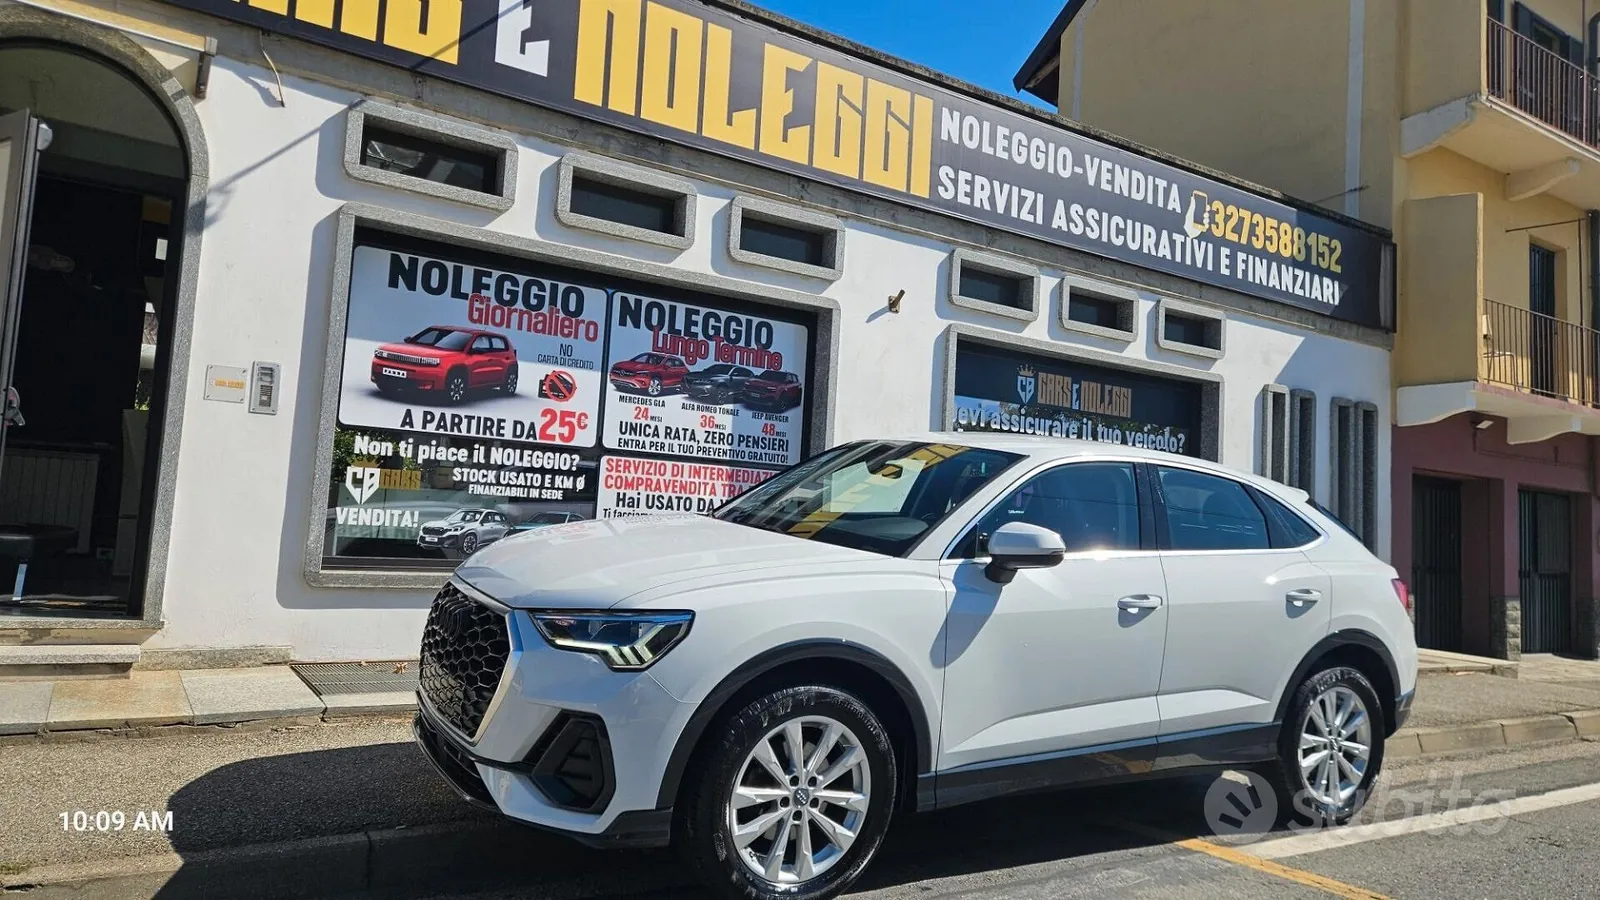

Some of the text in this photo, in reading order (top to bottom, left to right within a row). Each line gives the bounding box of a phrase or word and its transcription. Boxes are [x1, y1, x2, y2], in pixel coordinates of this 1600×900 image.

[574, 0, 934, 199] NOLEGGI
[939, 107, 1343, 274] NOLEGGIO-VENDITA 3273588152
[938, 164, 1340, 306] SERVIZI ASSICURATIVI E FINANZIARI
[388, 253, 585, 319] NOLEGGIO
[467, 292, 599, 343] Giornaliero
[618, 295, 774, 350] NOLEGGIO
[559, 343, 574, 358] NO
[651, 325, 783, 371] Lungo Termine
[537, 353, 594, 370] CARTA DI CREDITO
[618, 394, 666, 408] MERCEDES GLA
[681, 402, 696, 411] ALFA
[696, 404, 718, 414] ROMEO
[633, 406, 650, 421] 24
[699, 414, 716, 429] 36
[751, 411, 765, 420] JEEP
[400, 407, 589, 443] A PARTIRE DA 25€
[761, 422, 776, 437] 48
[990, 408, 1079, 440] assicurare
[1082, 417, 1093, 441] il
[1097, 423, 1122, 445] tuo
[1126, 426, 1186, 454] veicolo?
[618, 420, 790, 453] UNICA RATA, ZERO PENSIERI
[353, 434, 580, 471] Non ti piace il NOLEGGIO?
[617, 437, 789, 464] ENTRA PER IL TUO PREVENTIVO GRATUITO!
[452, 467, 498, 485] STOCK
[500, 470, 542, 487] USATO
[544, 474, 552, 488] E
[554, 475, 574, 489] KM
[605, 457, 668, 477] SERVIZIO
[670, 463, 686, 479] DI
[468, 484, 564, 500] FINANZIABILI IN SEDE
[603, 474, 744, 498] COMPRAVENDITA TRA
[615, 491, 715, 513] Hai USATO DA
[335, 506, 420, 528] VENDITA!
[602, 508, 611, 519] Ti
